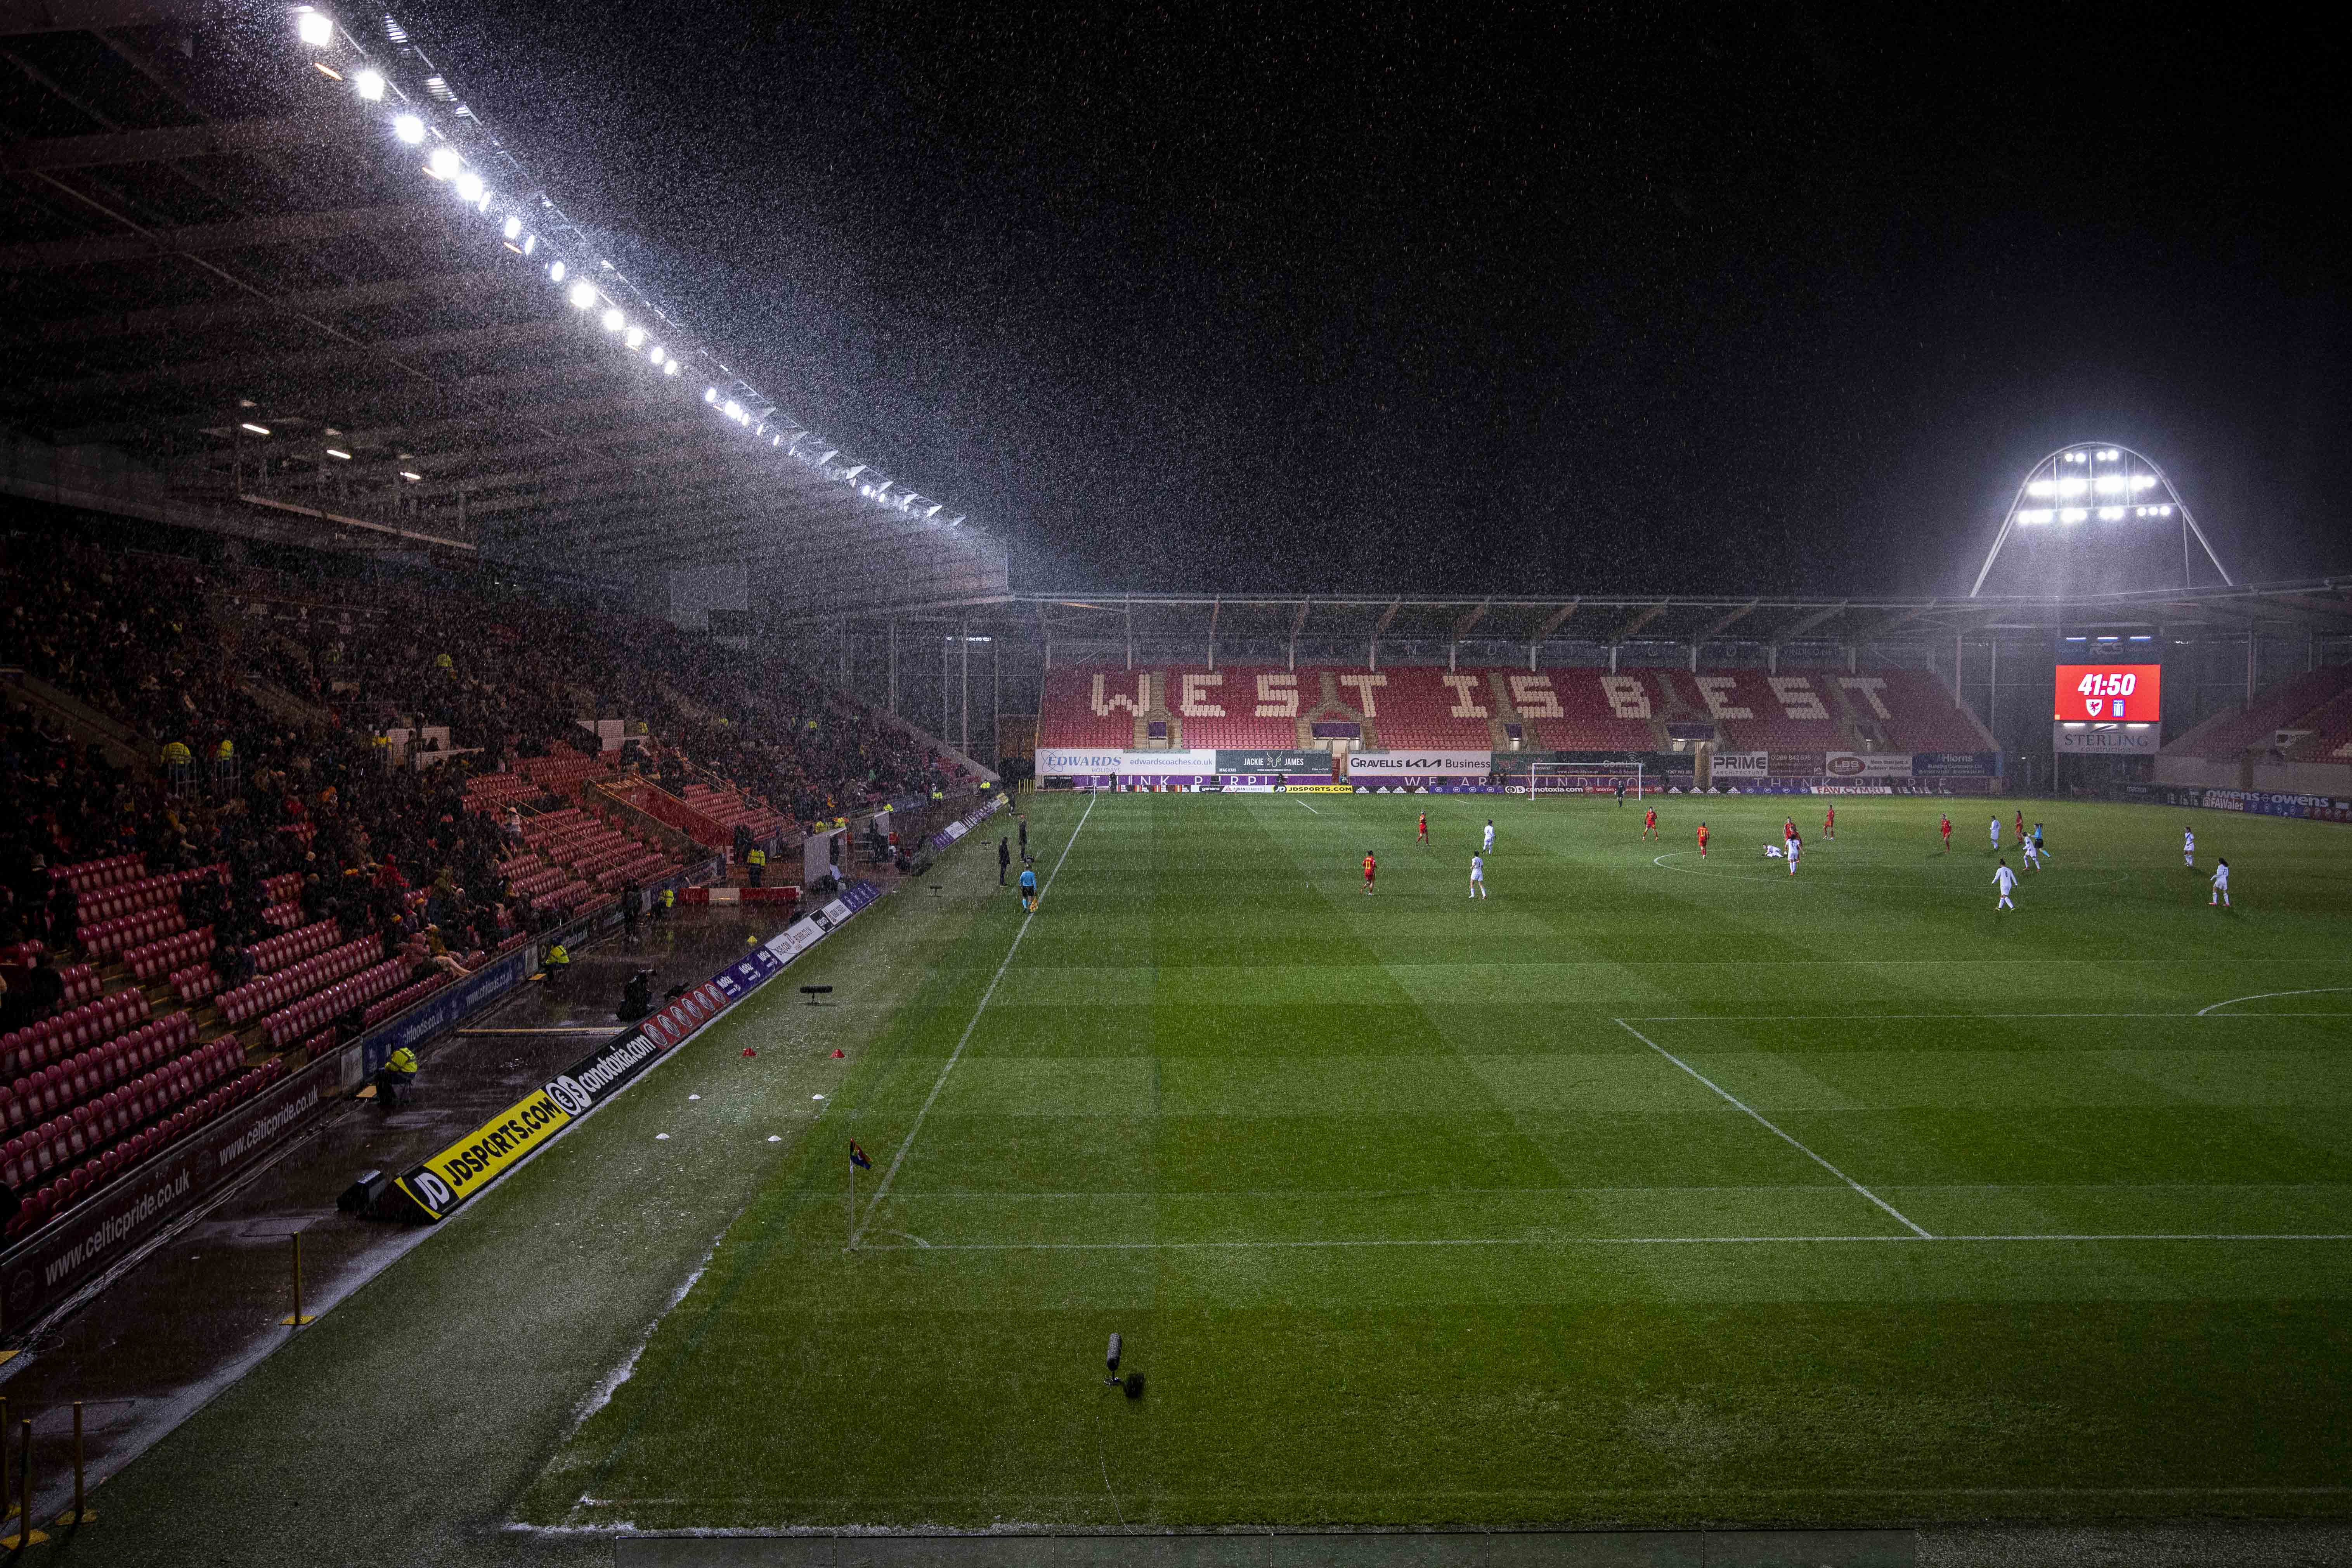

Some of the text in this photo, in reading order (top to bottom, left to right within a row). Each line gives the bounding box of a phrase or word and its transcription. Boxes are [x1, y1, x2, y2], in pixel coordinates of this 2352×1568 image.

[2078, 674, 2136, 696] 41:50
[1092, 674, 1890, 719] WEST IS BEST
[2064, 734, 2148, 747] STERLING
[1048, 756, 1121, 766] EDWARDS
[1244, 758, 1304, 766] JACKIE JAMES
[1351, 758, 1402, 768] GRAVELLS
[1446, 759, 1491, 768] Business
[1714, 757, 1766, 769] PRIME
[1943, 754, 1973, 762] Hiorns
[2203, 797, 2244, 811] @FAWales
[2206, 790, 2260, 802] owens
[2271, 794, 2329, 807] owens
[1366, 861, 1371, 870] 11
[578, 1034, 657, 1093] conotoxia.com
[218, 1084, 319, 1167] www.celticpride.co.uk
[414, 1098, 562, 1211] JD JDSPORTS.COM
[45, 1168, 190, 1287] www.celticpride.co.uk
